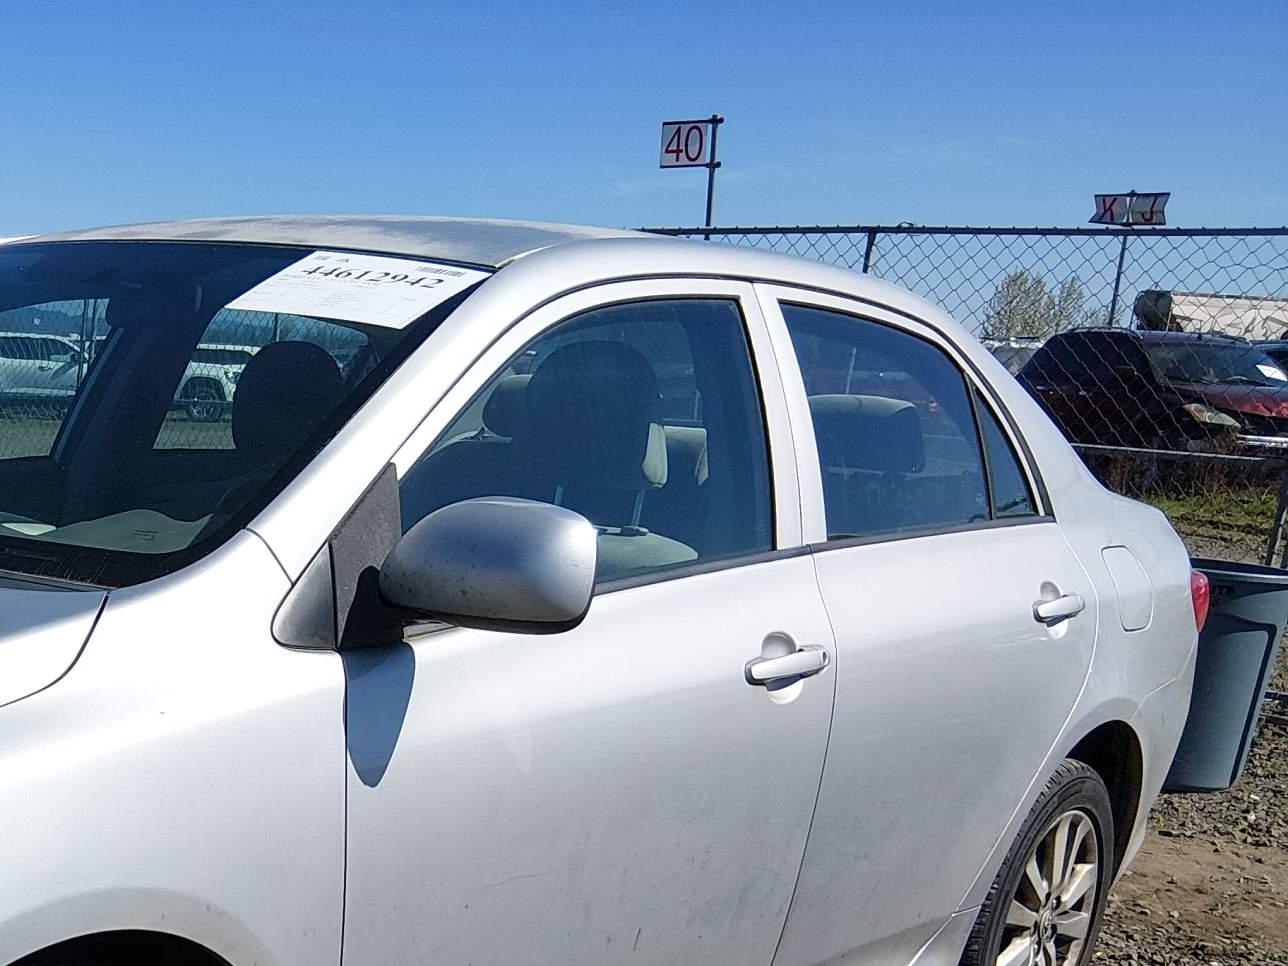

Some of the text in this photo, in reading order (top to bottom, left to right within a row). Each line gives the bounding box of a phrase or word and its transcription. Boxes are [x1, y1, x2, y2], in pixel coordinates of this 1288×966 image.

[664, 124, 704, 163] 40
[1099, 196, 1118, 222] K
[1141, 195, 1159, 222] J
[302, 264, 445, 290] 44612942
